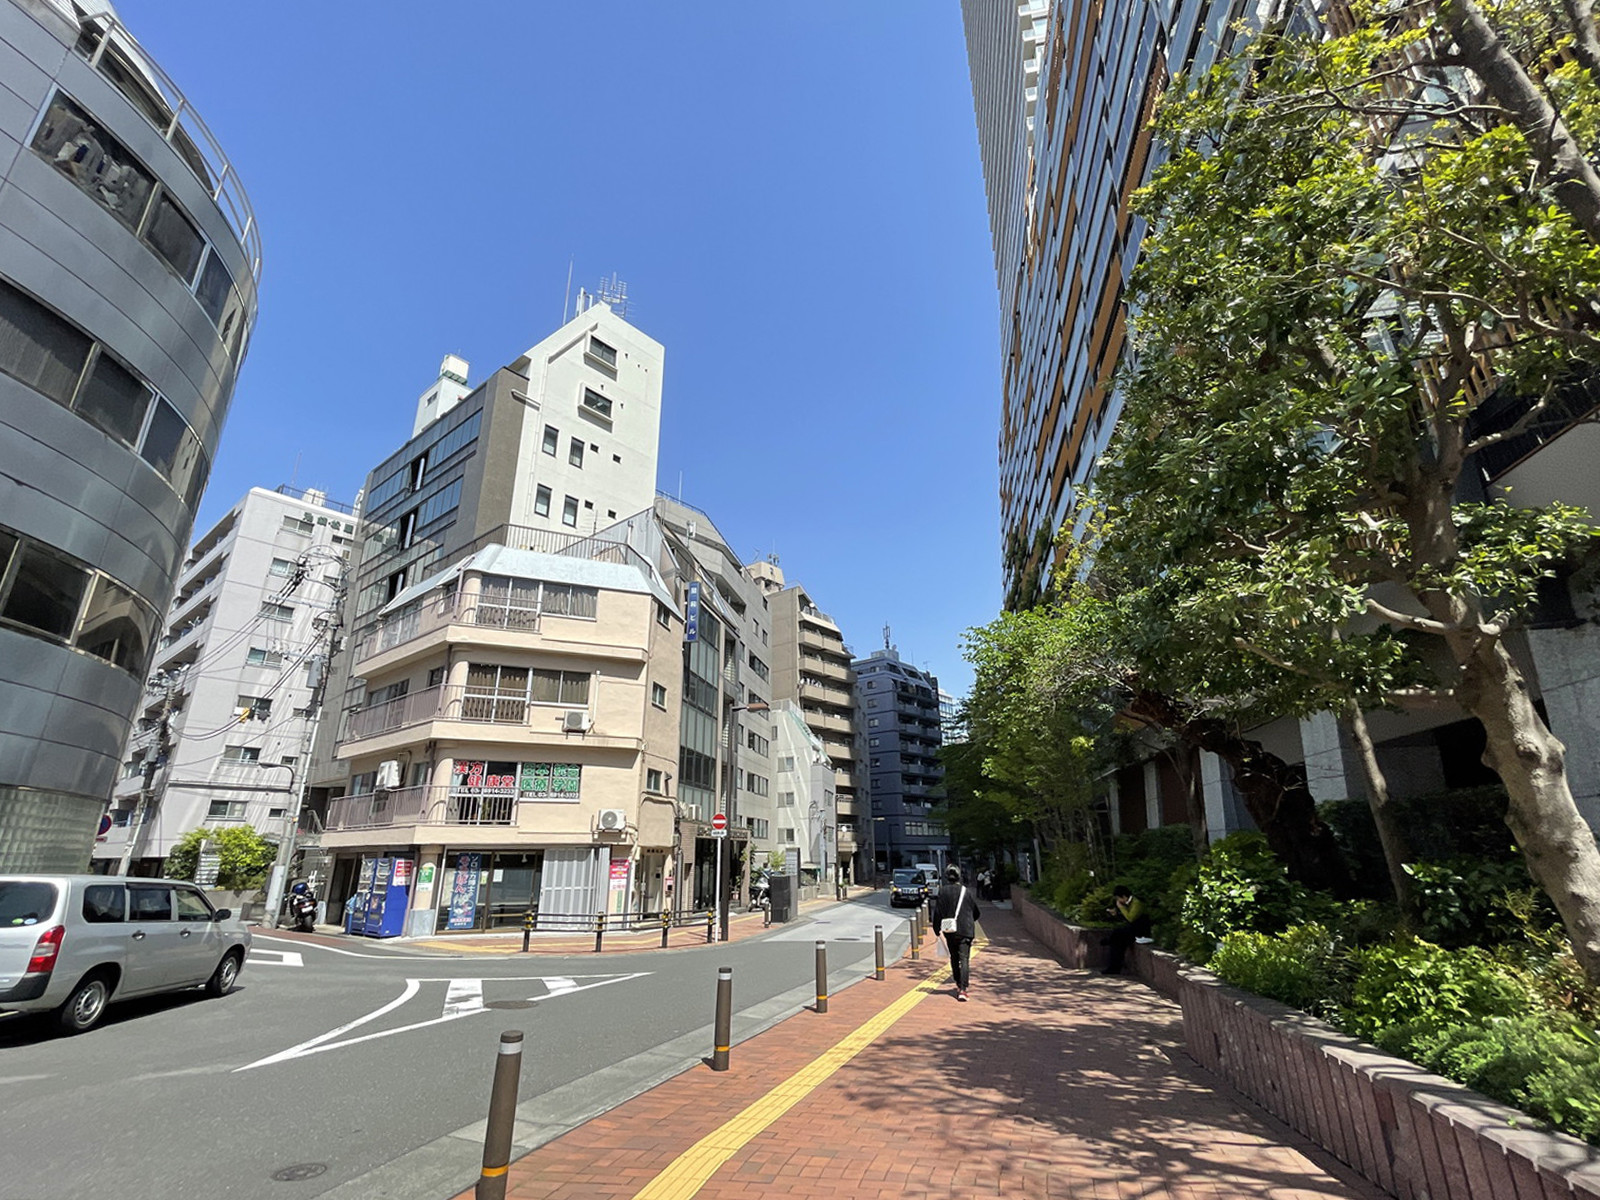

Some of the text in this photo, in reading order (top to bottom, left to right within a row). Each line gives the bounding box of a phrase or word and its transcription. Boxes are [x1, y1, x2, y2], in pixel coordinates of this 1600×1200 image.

[454, 760, 484, 775] 漢方
[467, 774, 515, 787] 健康堂
